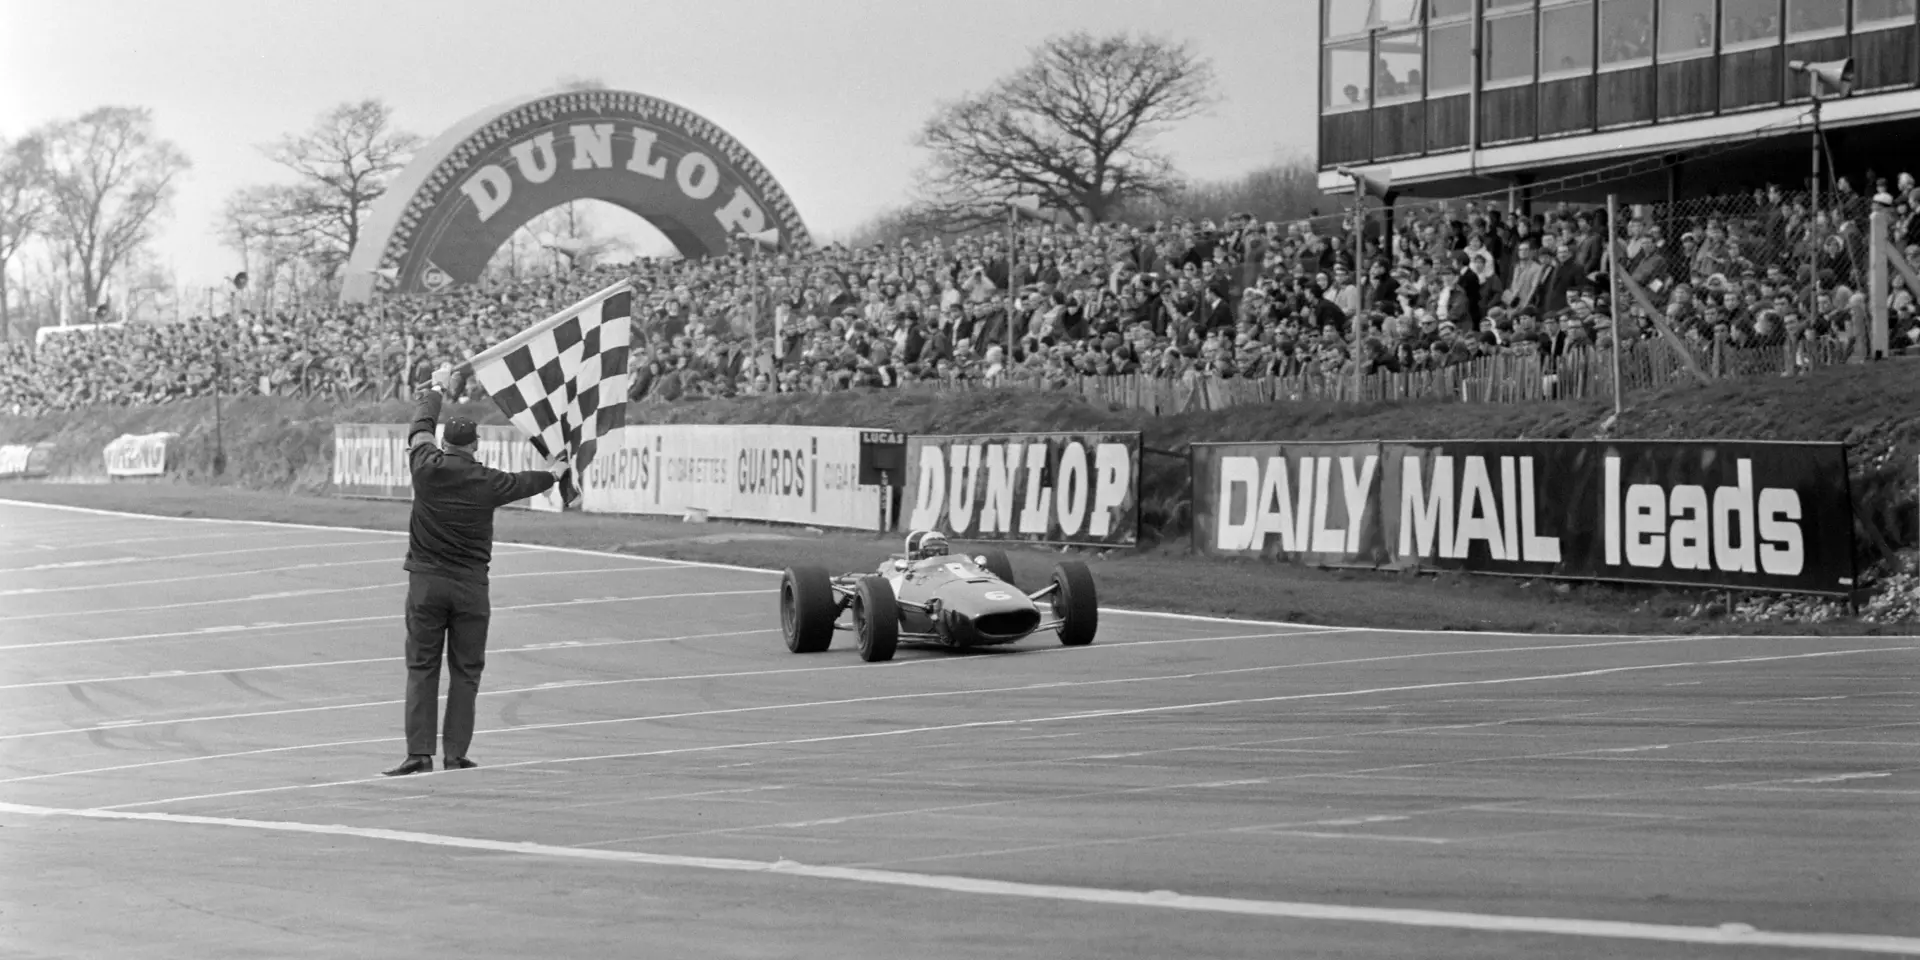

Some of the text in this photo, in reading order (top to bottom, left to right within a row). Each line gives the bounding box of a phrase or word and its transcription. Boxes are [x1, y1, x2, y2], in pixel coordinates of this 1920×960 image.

[461, 124, 764, 234] DUNLOP
[590, 447, 649, 490] GUARDS
[738, 448, 804, 497] GUARDS
[863, 432, 904, 444] LUCAS
[910, 442, 1130, 536] DUNLOP
[1217, 456, 1803, 576] DAILY MAIL leads
